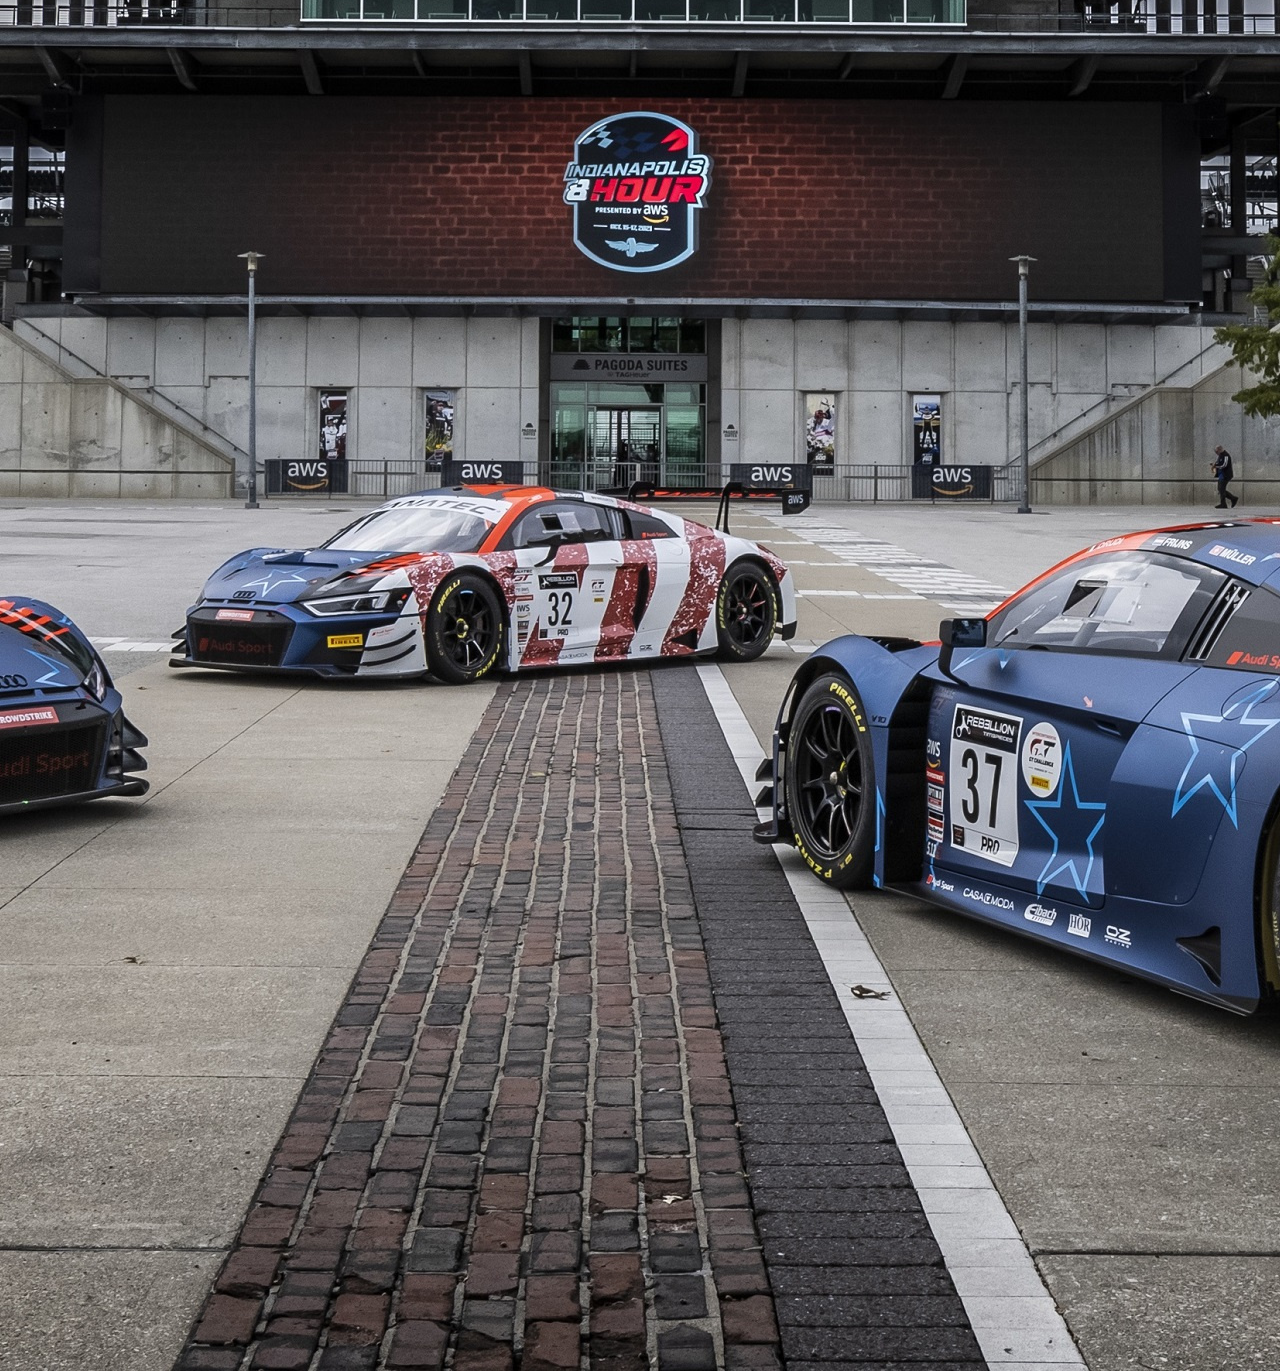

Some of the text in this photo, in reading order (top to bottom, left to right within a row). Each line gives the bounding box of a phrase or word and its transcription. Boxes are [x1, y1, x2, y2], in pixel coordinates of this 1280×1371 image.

[567, 159, 704, 178] INDIANAPOLIS
[566, 177, 704, 203] 8 HOUR
[595, 204, 669, 216] PRESENTED BY aws
[594, 359, 688, 371] PAGODA SUITES
[287, 461, 327, 478] aws
[461, 462, 503, 479] aws
[750, 466, 792, 482] aws
[932, 467, 972, 483] aws
[787, 494, 804, 505] aws
[1219, 546, 1257, 566] MÜLLER
[547, 591, 573, 627] 32
[330, 636, 360, 645] PIRELLI
[557, 628, 569, 636] PRO
[210, 640, 273, 655] Audi Sport
[1241, 652, 1270, 665] Audi
[829, 682, 866, 733] PIRELLI
[871, 714, 888, 724] V10
[966, 714, 1015, 737] REBELLION
[36, 750, 89, 778] Sport
[961, 747, 1003, 829] 37
[980, 835, 1000, 856] PRO
[1024, 903, 1057, 921] Eibach
[1106, 925, 1131, 942] OZ
